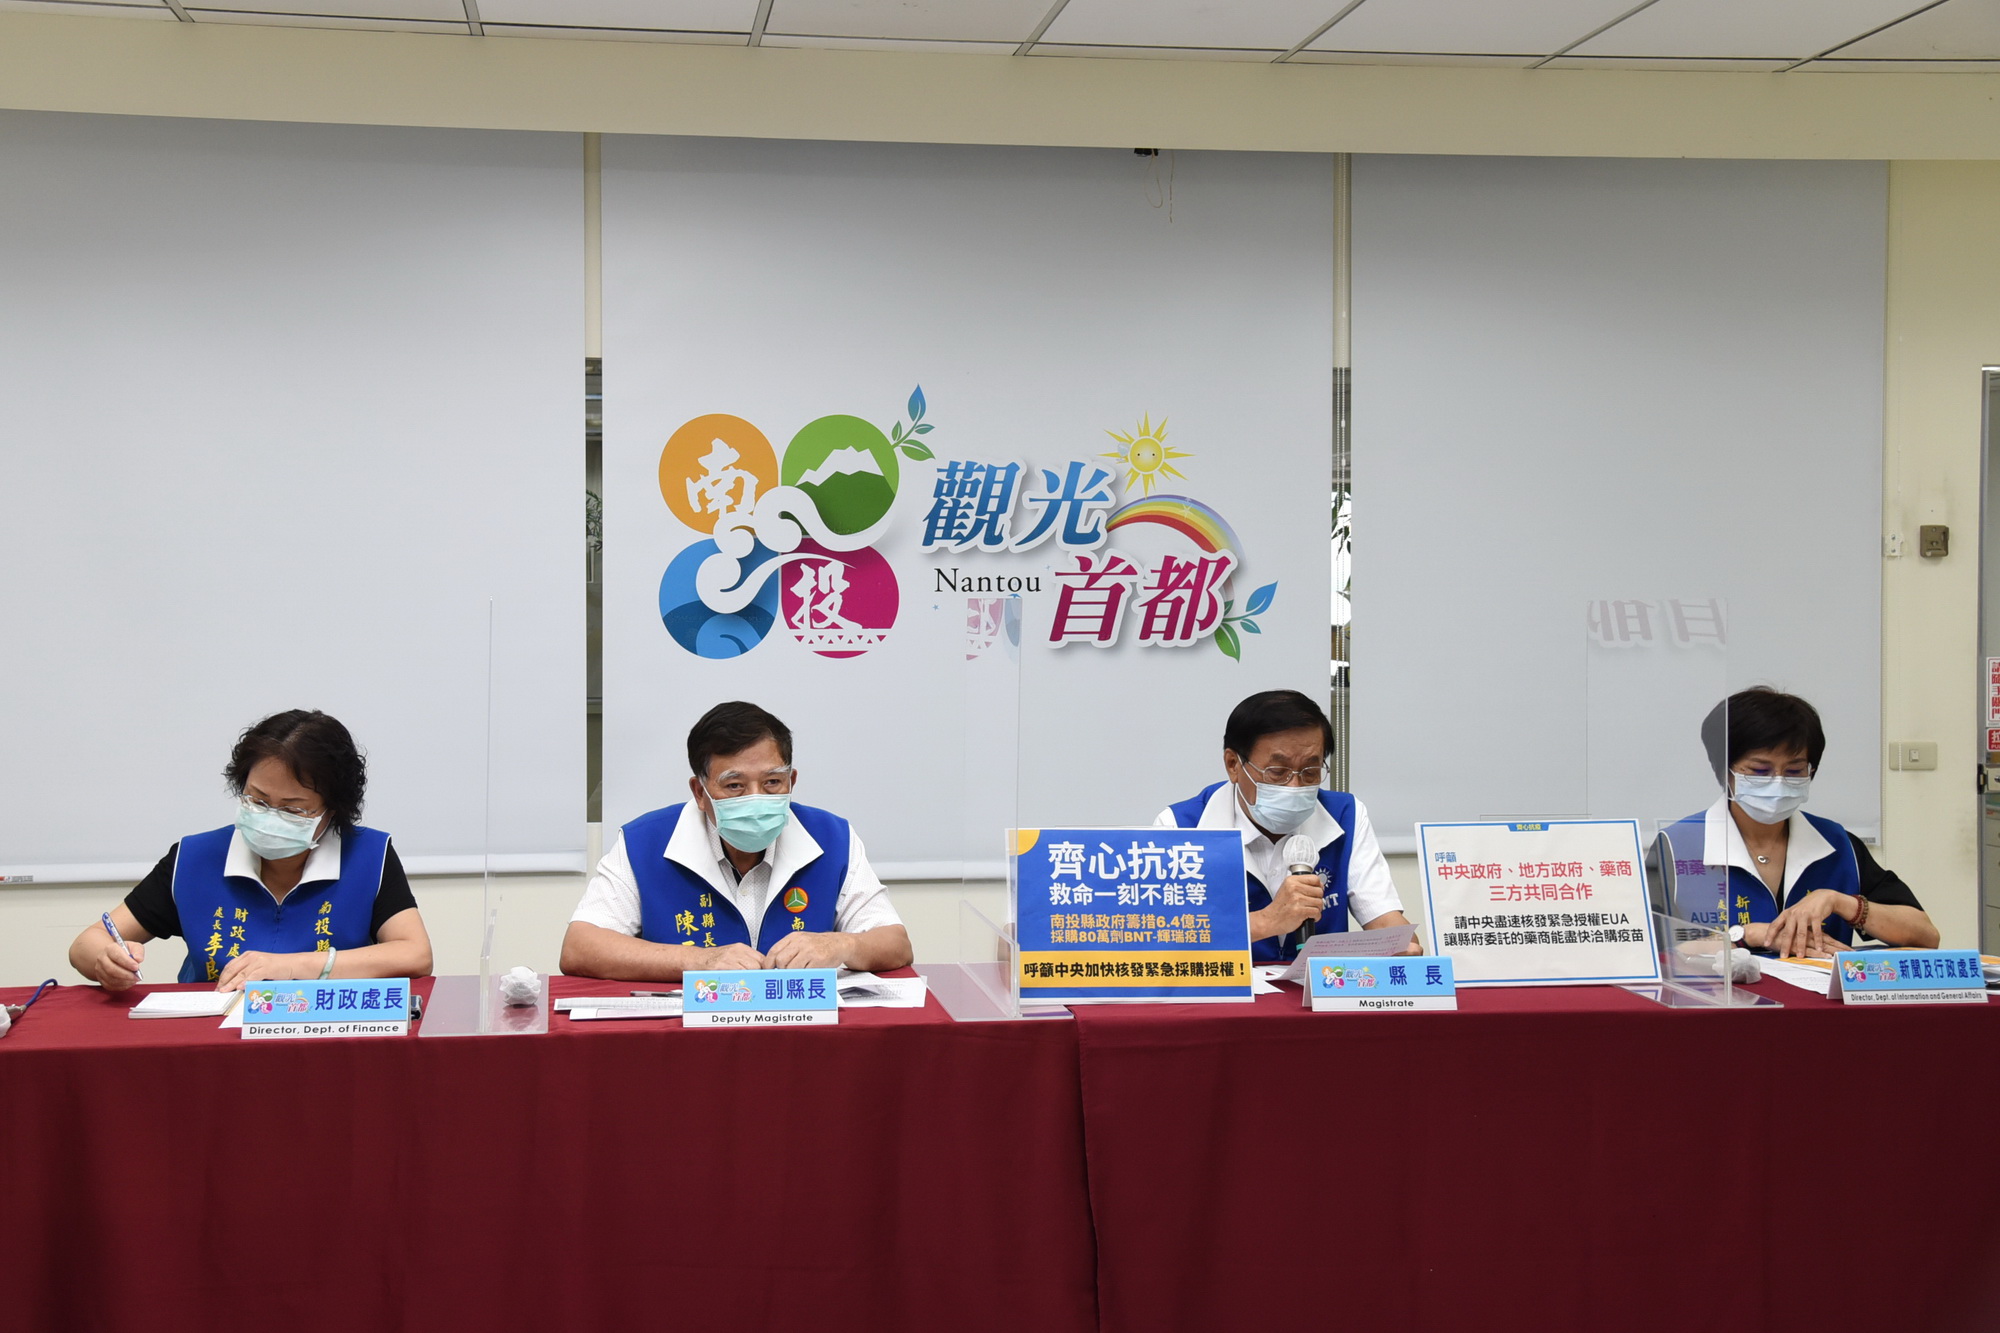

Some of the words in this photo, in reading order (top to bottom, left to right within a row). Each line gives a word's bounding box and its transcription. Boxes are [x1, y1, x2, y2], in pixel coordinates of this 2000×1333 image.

[685, 437, 760, 519] 南
[922, 460, 1109, 547] 觀光
[934, 568, 1042, 593] Nantou
[789, 559, 863, 630] 投
[1049, 555, 1232, 642] 首都
[1048, 841, 1206, 881] 齊心抗疫
[1435, 851, 1457, 863] 呼籲
[1438, 860, 1633, 880] 中央政府、地方政府、藥商
[1049, 882, 1208, 906] 救命一刻不能等
[1322, 893, 1339, 910] MT
[1489, 883, 1593, 902] 三方共同合作
[699, 892, 717, 948] 副縣長
[1050, 914, 1212, 929] 南投縣政府籌措6.4億元
[1454, 913, 1630, 930] 請中央盡速核發緊急授權EUA
[1050, 929, 1212, 944] 採購80萬劑BNT-輝瑞疫苗
[1444, 929, 1645, 947] 讓縣府委託的藥商能盡快洽購疫苗
[1023, 961, 1245, 978] 呼籲中央加快核發緊急採購授權！
[1899, 957, 1981, 980] 新聞及行政處長
[765, 978, 827, 999] 副縣長
[1897, 992, 1929, 1000] Information
[1930, 992, 1941, 1000] and
[1941, 991, 1963, 999] General
[315, 988, 403, 1010] 財政處長
[1359, 999, 1414, 1008] Magistrate
[712, 1015, 751, 1024] Deputy
[754, 1014, 813, 1023] Magistrate
[250, 1026, 300, 1035] Director,
[304, 1025, 335, 1035] Dept.
[338, 1025, 350, 1033] of
[353, 1024, 399, 1033] Finance
